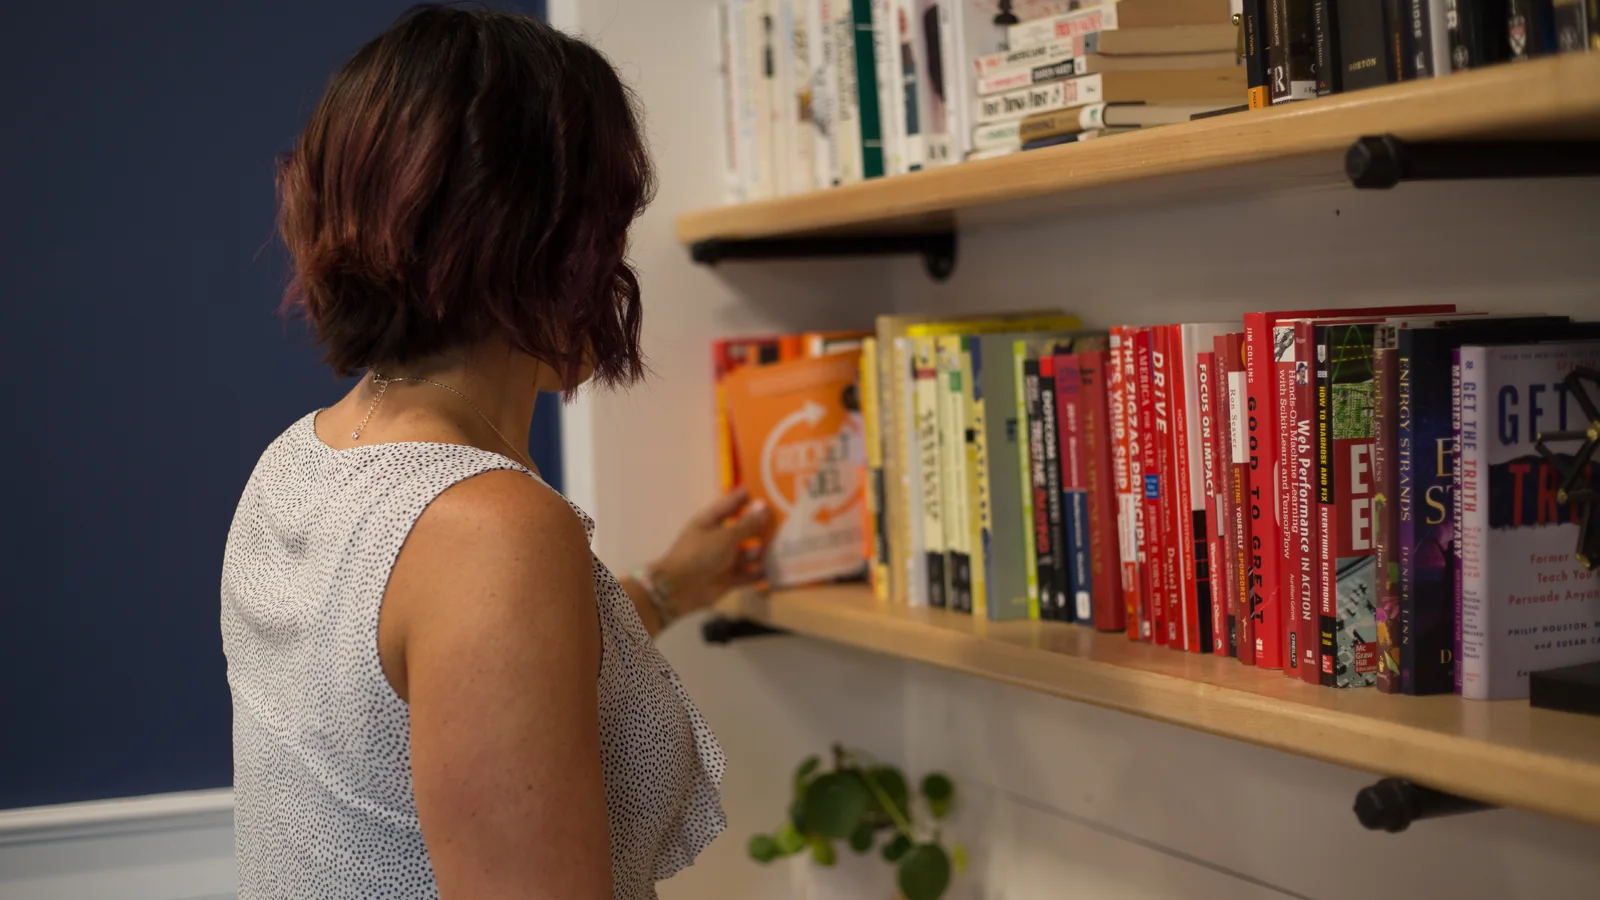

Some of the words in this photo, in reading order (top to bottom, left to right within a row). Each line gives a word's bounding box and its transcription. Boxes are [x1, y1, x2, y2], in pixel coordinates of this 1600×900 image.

[1109, 350, 1123, 384] IT'S
[1123, 336, 1135, 376] THE
[1199, 363, 1209, 413] FOCUS
[1279, 369, 1287, 396] with
[1288, 369, 1298, 427] Hands-On
[1374, 370, 1384, 418] herbal
[1399, 357, 1410, 432] ENERGY
[1452, 365, 1461, 430] MARRIED
[1463, 382, 1477, 412] GET
[1112, 389, 1125, 440] YOUR
[1125, 381, 1140, 455] ZIGZAG
[1138, 345, 1150, 407] AMERICA
[1144, 432, 1154, 468] SALE
[1202, 416, 1210, 438] ON
[1319, 409, 1326, 420] TO
[1498, 383, 1571, 446] GET
[1178, 434, 1184, 447] TO
[1247, 396, 1258, 470] GOOD
[1280, 398, 1289, 466] Scikit-Learn
[1290, 430, 1298, 479] Machine
[1297, 419, 1311, 453] Web
[1319, 423, 1327, 465] DIAGNOSE
[1374, 421, 1384, 483] goddess
[1452, 434, 1461, 452] TO
[1463, 420, 1477, 450] THE
[1116, 445, 1128, 490] SHIP
[1180, 467, 1188, 491] YOUR
[1204, 442, 1214, 498] IMPACT
[1281, 468, 1290, 490] and
[1351, 444, 1376, 494] E
[1400, 437, 1410, 521] STRANDS
[1453, 457, 1461, 484] THE
[1463, 459, 1477, 512] TRUTH
[1131, 461, 1146, 564] PRINCIPLE
[1181, 493, 1190, 553] COMPETITION
[1250, 486, 1260, 520] TO
[1282, 493, 1291, 559] TensorFlow
[1291, 482, 1299, 533] Learning
[1298, 458, 1311, 553] Performance
[1425, 485, 1453, 524] S
[1453, 489, 1462, 559] MILITARY
[1167, 547, 1178, 590] Daniel
[1238, 552, 1246, 603] SPONSORED
[1252, 535, 1264, 624] GREAT
[1301, 557, 1310, 571] IN
[1530, 553, 1569, 565] Former
[1537, 570, 1568, 583] Teach
[1572, 569, 1592, 580] You
[1211, 574, 1220, 634] Lipton-Dibner
[1301, 574, 1311, 621] ACTION
[1508, 590, 1560, 605] Persuade
[1565, 589, 1600, 602] Anyon
[1402, 610, 1410, 645] LINN
[1508, 627, 1538, 636] PHILIP
[1534, 642, 1552, 650] and
[1556, 638, 1587, 648] SUSAN
